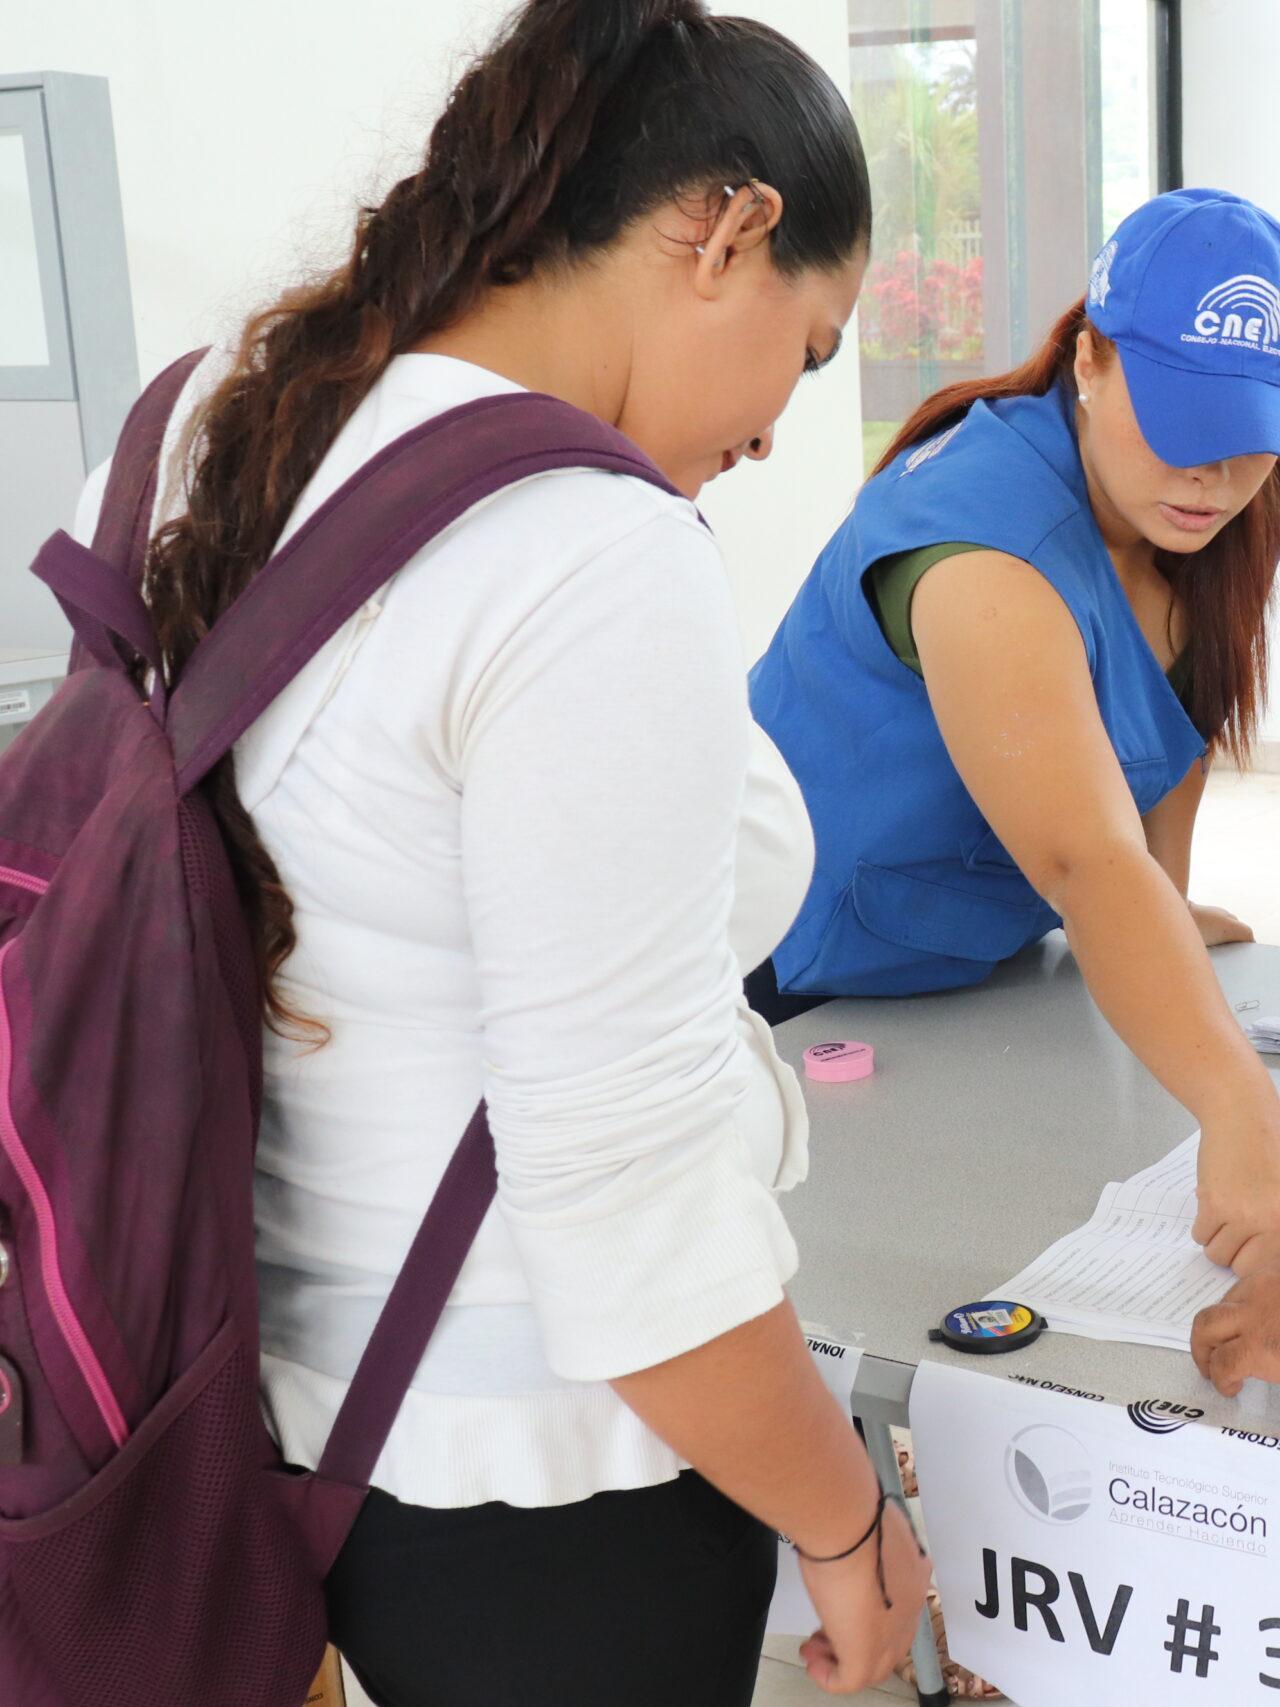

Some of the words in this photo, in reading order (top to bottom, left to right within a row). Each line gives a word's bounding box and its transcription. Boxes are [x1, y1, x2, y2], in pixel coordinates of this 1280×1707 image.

[1180, 334, 1217, 344] CONSEJO
[1220, 338, 1261, 350] NACIONAL
[1194, 310, 1263, 341] CNE
[1039, 1380, 1105, 1402] CONSEJO
[1108, 1461, 1150, 1480] Instituto
[1153, 1470, 1219, 1494] Tecnológico
[1222, 1485, 1268, 1506] Superior
[1108, 1477, 1267, 1537] Calazacón
[1108, 1508, 1181, 1533] Aprender
[1189, 1526, 1267, 1554] Haciendo
[974, 1548, 1134, 1657] JRV
[1163, 1598, 1221, 1679] #
